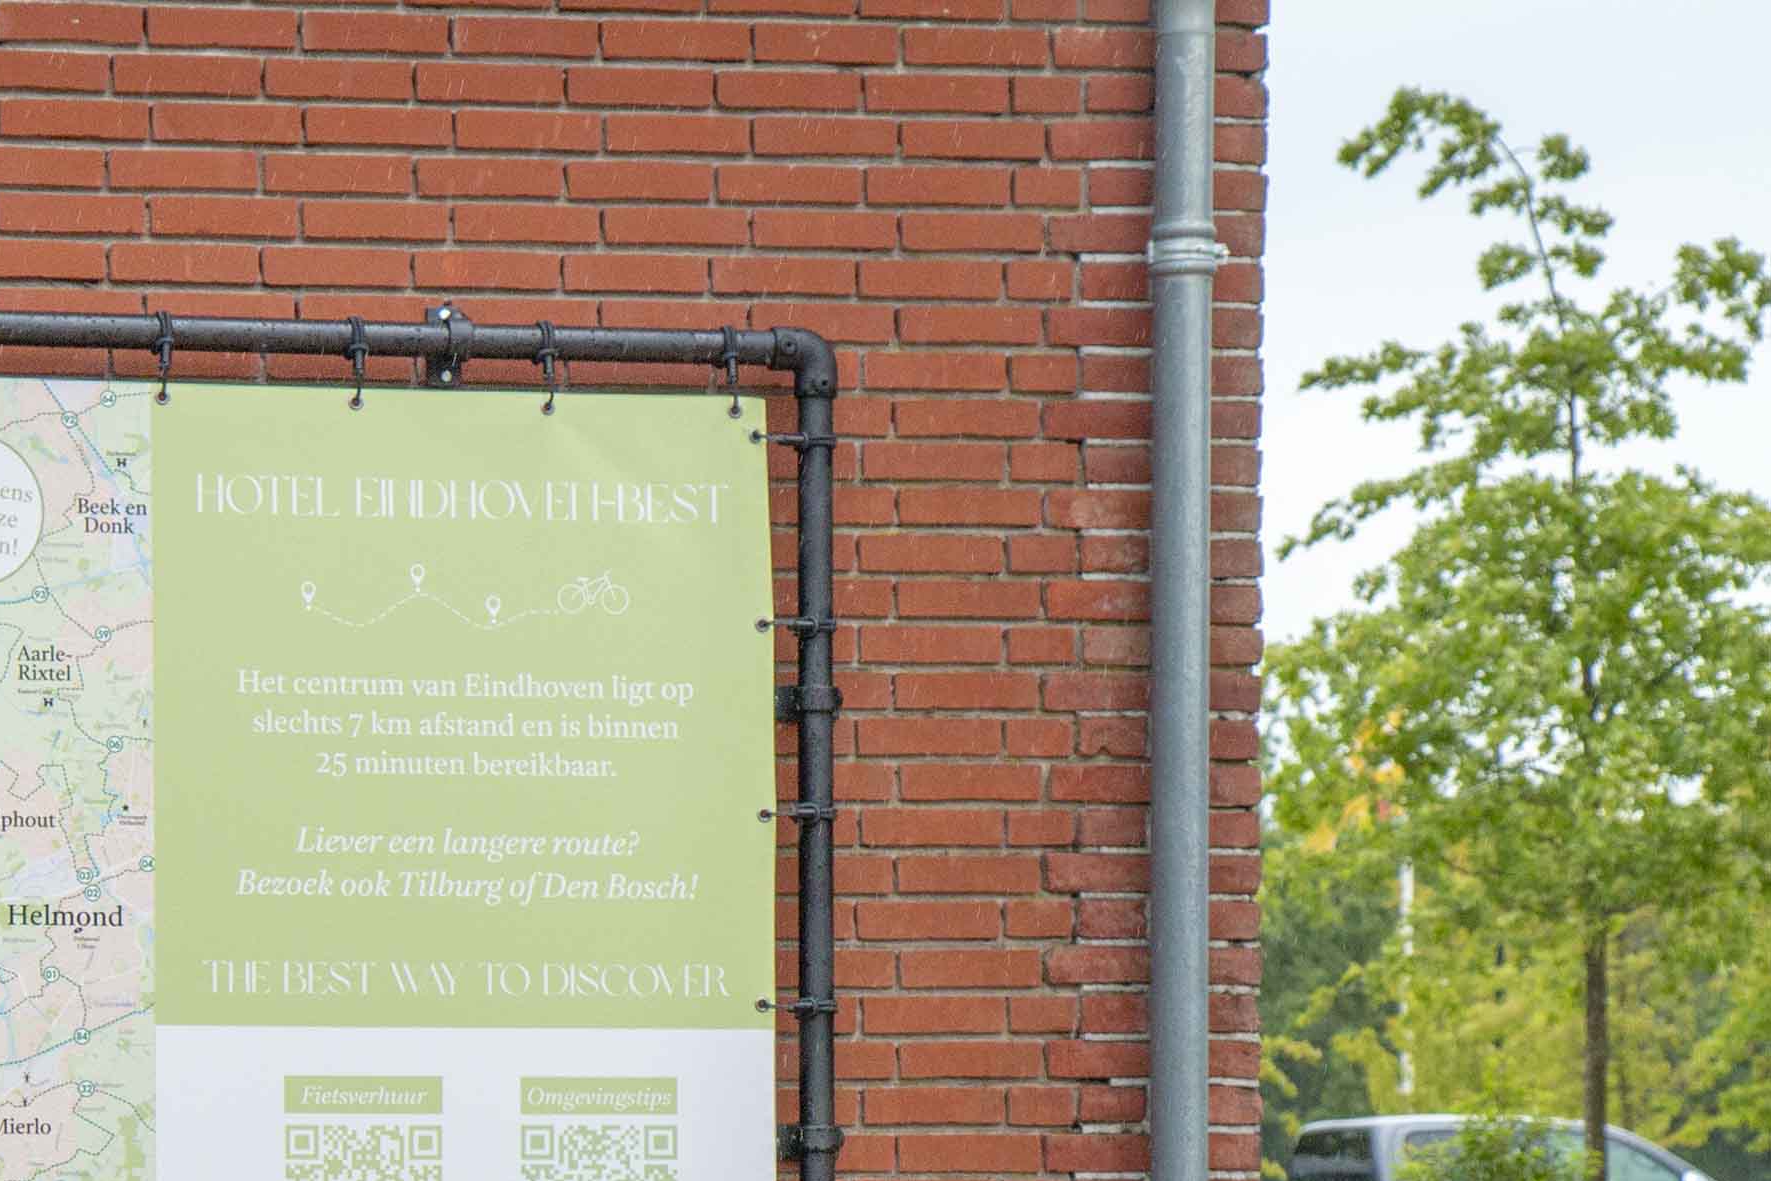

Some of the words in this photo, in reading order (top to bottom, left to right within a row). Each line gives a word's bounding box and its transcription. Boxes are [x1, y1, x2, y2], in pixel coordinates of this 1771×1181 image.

[77, 497, 120, 515] Beek
[125, 502, 147, 515] en
[196, 474, 340, 518] HOTEL
[355, 478, 729, 526] EINDHOVEN-BEST
[84, 517, 135, 535] Donk
[18, 645, 73, 663] Aarle-
[18, 664, 70, 681] Rixtel
[237, 668, 283, 695] Het
[293, 674, 404, 696] centrum
[412, 678, 456, 696] van
[464, 674, 604, 700] Eindhoven
[612, 676, 654, 706] ligt
[661, 682, 694, 706] op
[252, 708, 342, 736] slechts
[348, 714, 362, 738] 7
[371, 710, 411, 736] km
[419, 710, 514, 738] afstand
[522, 718, 553, 738] en
[561, 712, 580, 738] is
[588, 712, 678, 740] binnen
[316, 752, 347, 776] 25
[355, 754, 465, 776] minuten
[473, 752, 617, 778] bereikbaar.
[296, 825, 382, 855] Liever
[388, 834, 434, 855] een
[443, 827, 546, 860] langere
[552, 831, 640, 857] route?
[236, 869, 334, 896] Bezoek
[341, 870, 389, 896] ook
[398, 871, 502, 906] Tilburg
[509, 872, 543, 905] of
[543, 872, 598, 899] Den
[606, 873, 700, 900] Bosch!
[8, 905, 123, 928] Helmond
[202, 960, 270, 994] THE
[284, 961, 377, 995] BEST
[390, 962, 467, 996] WAY
[477, 963, 530, 997] TO
[542, 964, 731, 998] DISCOVER
[300, 1085, 428, 1107] Fietsverhuur
[528, 1087, 672, 1112] Omgevingstips
